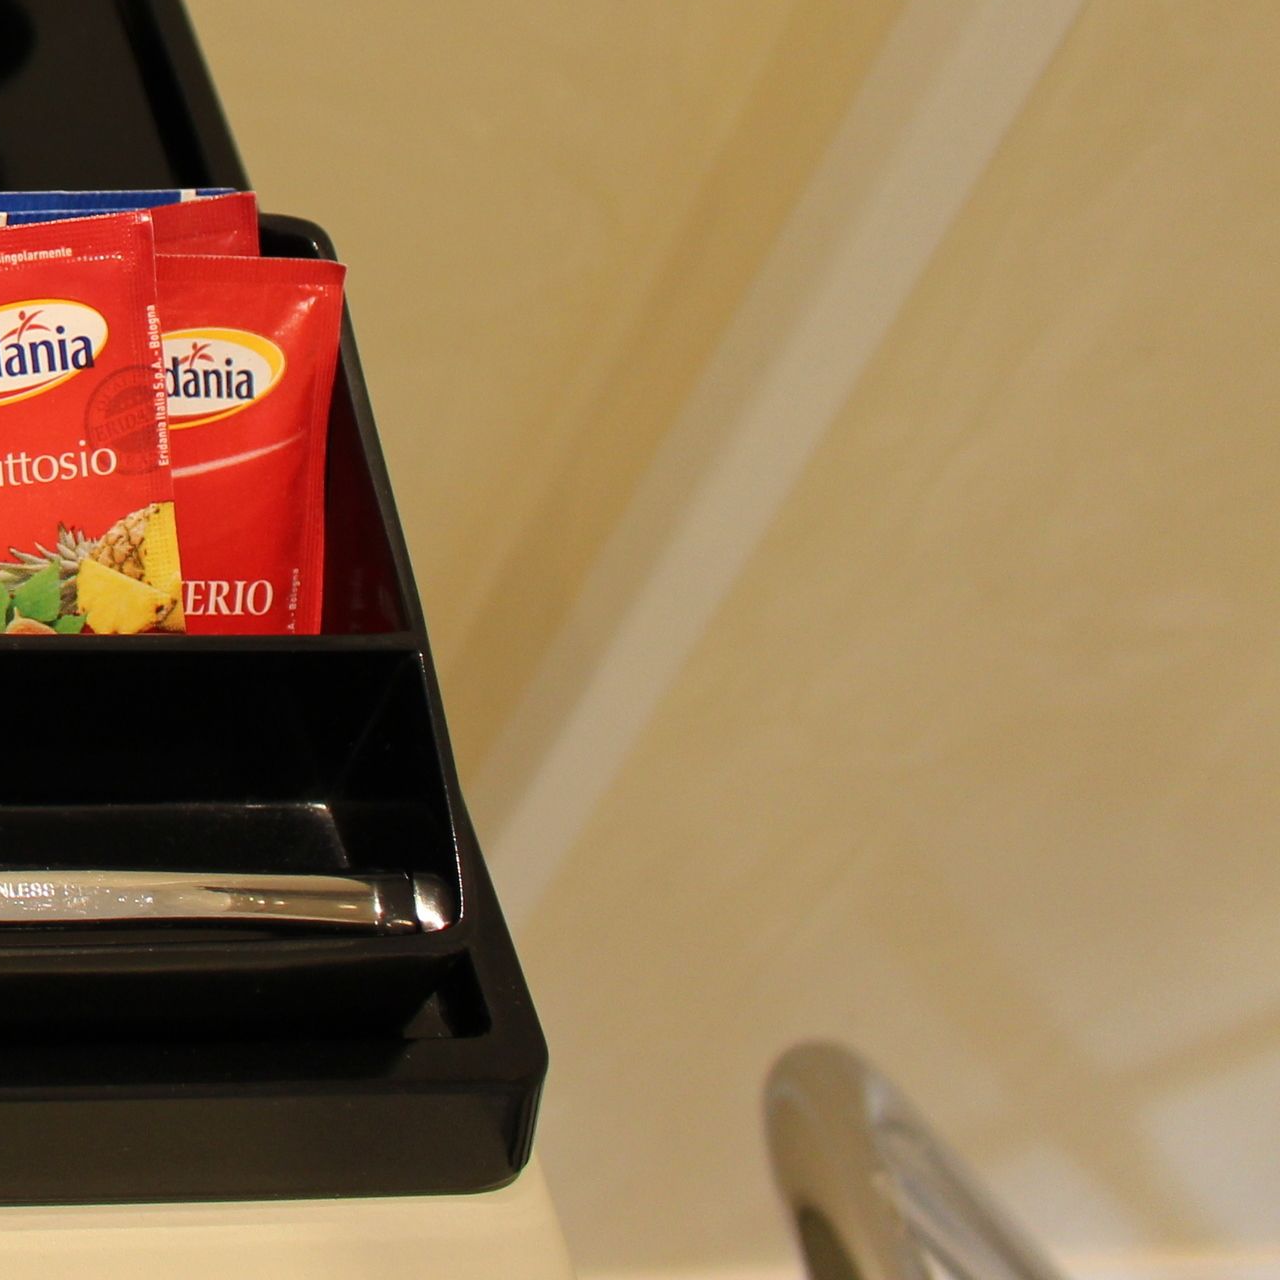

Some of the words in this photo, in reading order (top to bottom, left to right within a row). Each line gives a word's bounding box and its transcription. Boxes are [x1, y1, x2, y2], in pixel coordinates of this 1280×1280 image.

[146, 304, 161, 349] Bologna
[165, 356, 255, 400] dania
[154, 391, 166, 421] Italia
[156, 422, 170, 466] Eridania
[181, 579, 274, 616] ERIO
